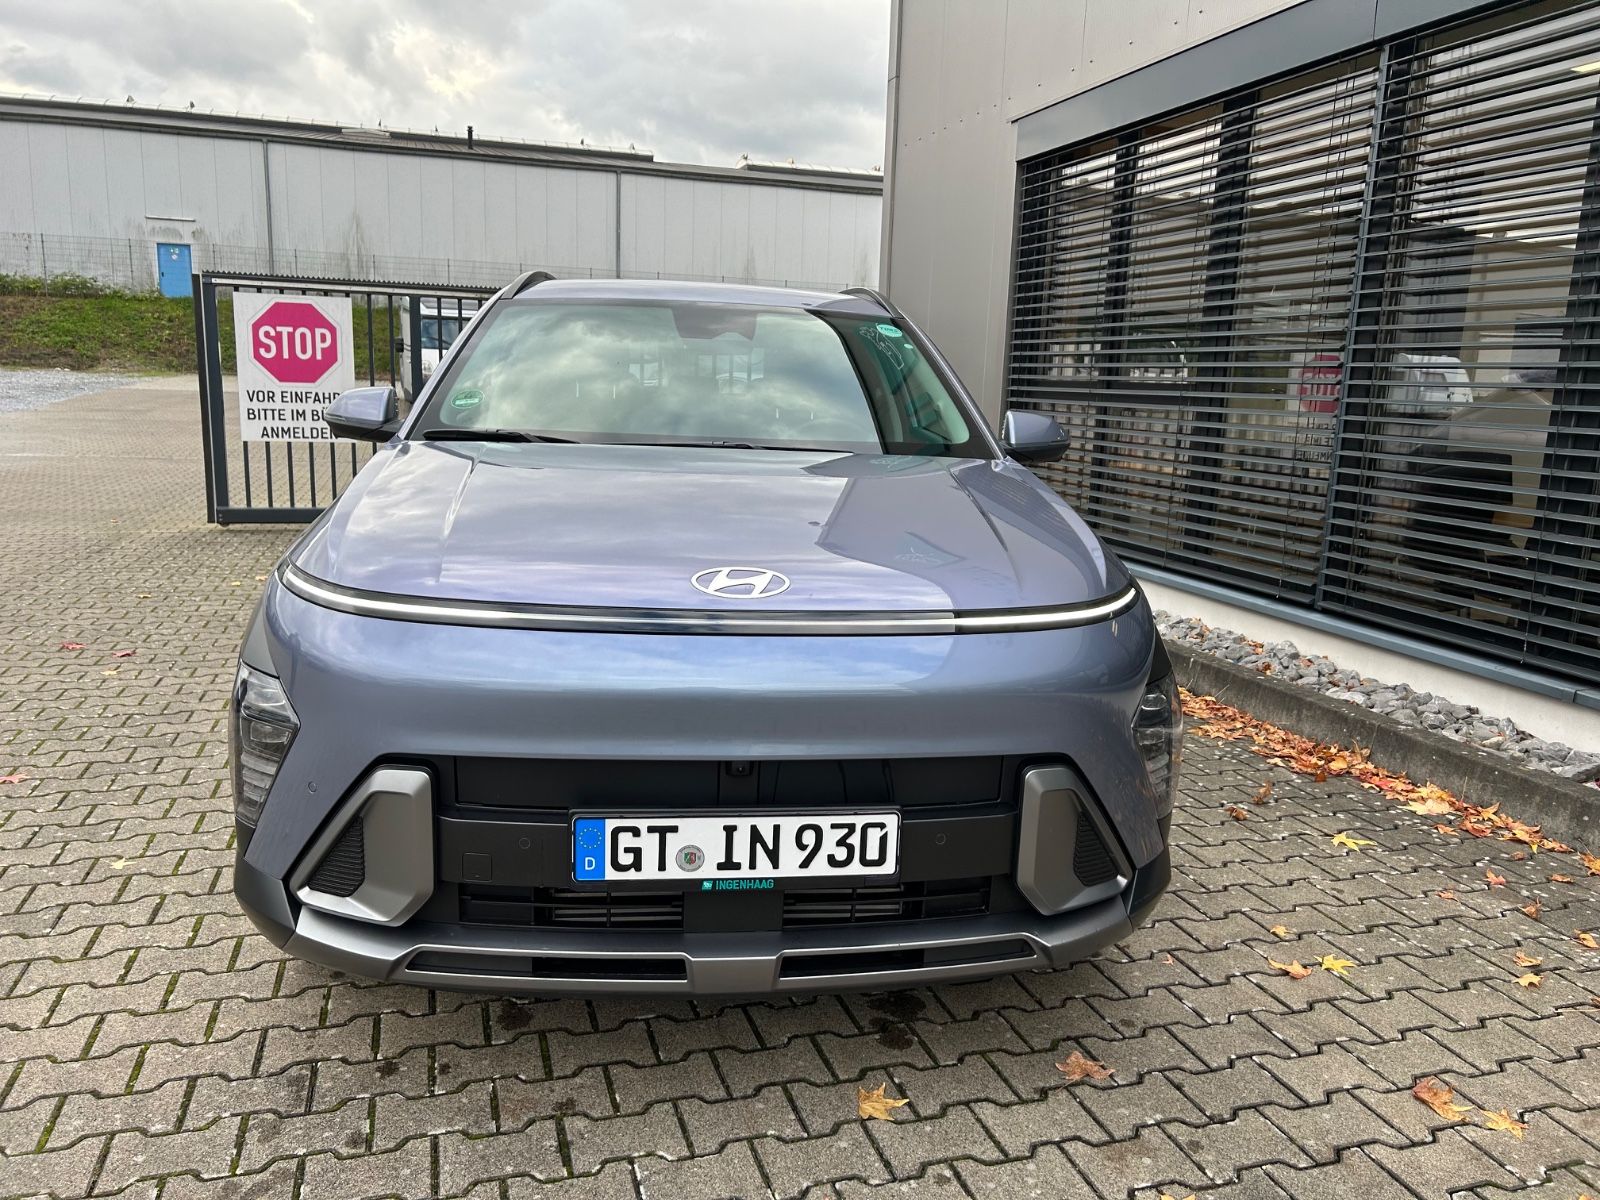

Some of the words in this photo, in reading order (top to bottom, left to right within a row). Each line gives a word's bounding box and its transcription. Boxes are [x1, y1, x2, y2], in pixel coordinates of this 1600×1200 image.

[258, 325, 332, 360] STOP
[246, 390, 276, 404] VOR
[247, 408, 287, 421] BITTE
[291, 409, 307, 422] IM
[610, 825, 679, 872] GT
[716, 824, 781, 871] IN
[794, 821, 889, 869] 930
[584, 857, 596, 871] D
[715, 879, 775, 890] INGENHAAG
